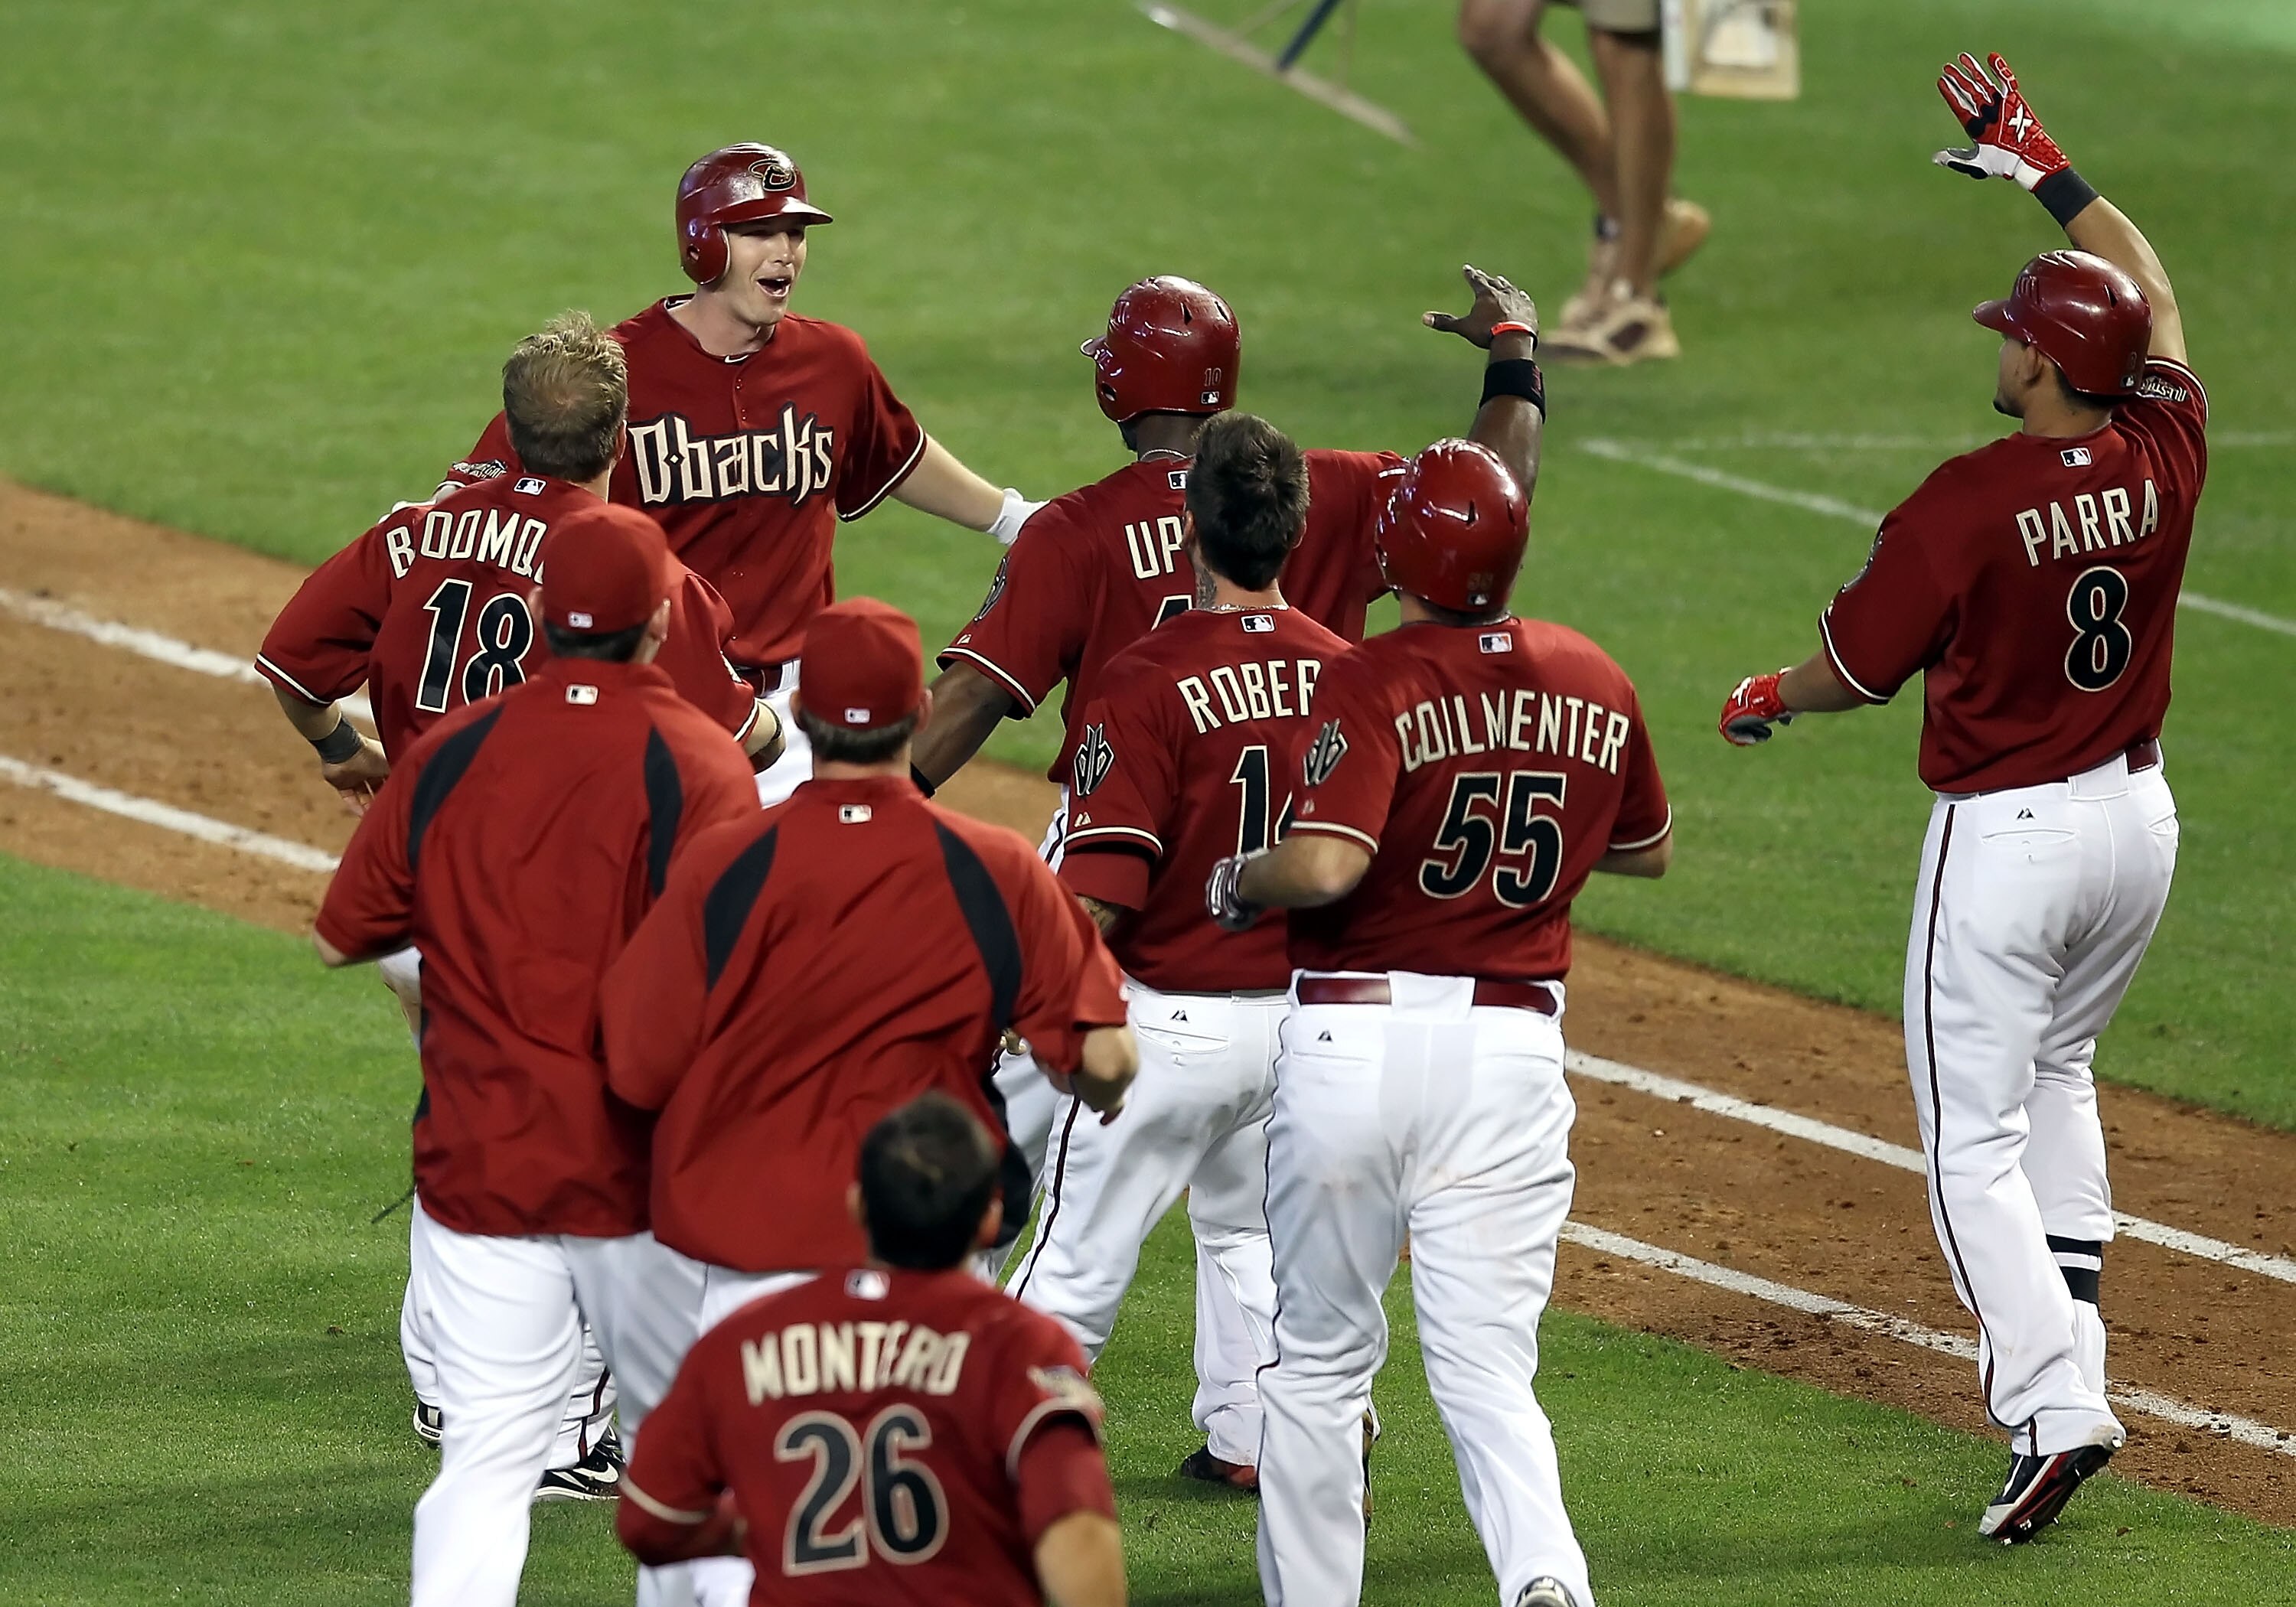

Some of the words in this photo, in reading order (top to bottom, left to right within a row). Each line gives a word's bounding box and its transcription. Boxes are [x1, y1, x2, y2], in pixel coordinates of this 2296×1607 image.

[1204, 367, 1221, 386] 10
[2015, 479, 2159, 567] PARRA
[416, 578, 534, 713] 18
[2065, 566, 2132, 693] 8
[1418, 770, 1567, 909] 55
[740, 1319, 973, 1407] MONTERO
[773, 1403, 950, 1578] 26
